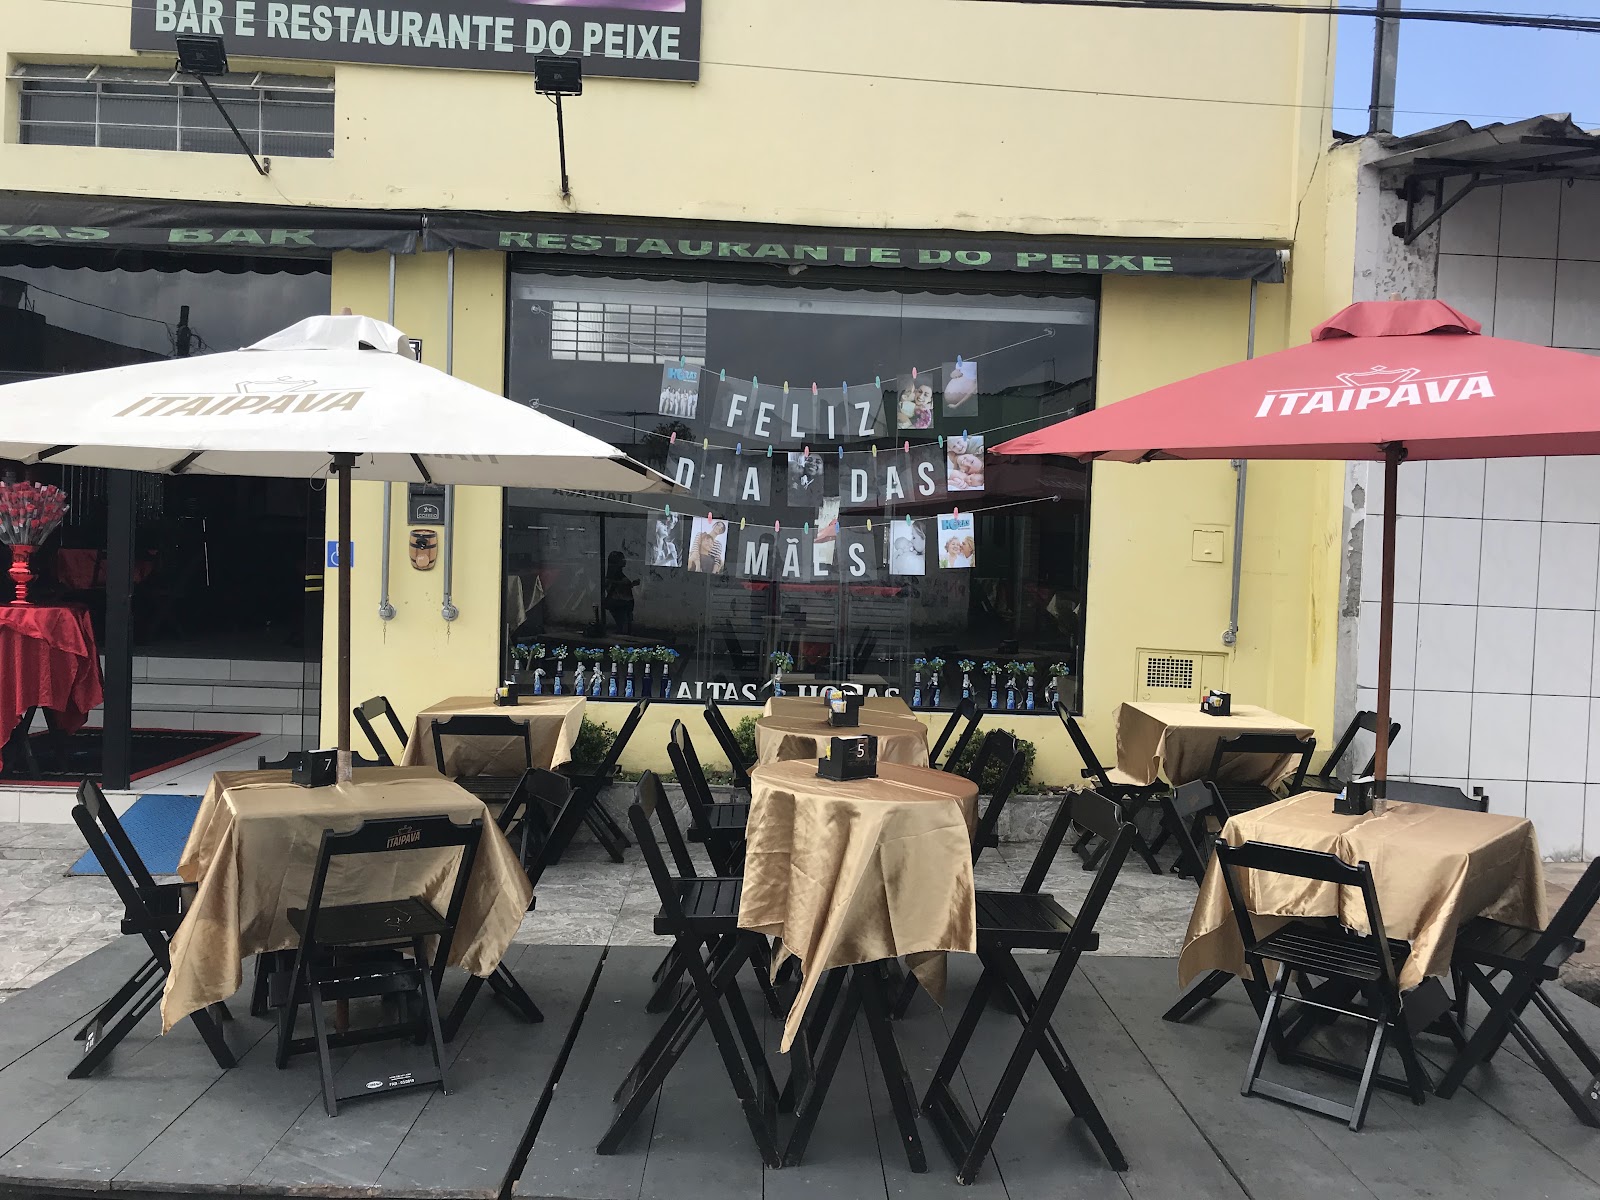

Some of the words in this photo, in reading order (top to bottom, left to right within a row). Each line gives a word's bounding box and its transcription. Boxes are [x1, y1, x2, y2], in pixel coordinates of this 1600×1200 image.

[155, 0, 224, 35] BAR
[235, 1, 255, 37] E
[267, 2, 515, 53] RESTAURANTE
[525, 18, 572, 56] DO
[582, 21, 681, 61] PEIXE
[0, 224, 110, 240] AS
[167, 227, 317, 246] BAR
[498, 231, 901, 263] RESTAURANTE
[918, 248, 993, 266] DO
[1016, 251, 1174, 272] PEIXE
[111, 390, 367, 417] ITAIPAVA
[1254, 375, 1496, 418] ITAIPAVA
[726, 393, 876, 440] FELIZ
[675, 456, 761, 501] DIA
[851, 461, 936, 503] DAS
[744, 537, 867, 577] MÃES
[324, 758, 332, 771] 7
[856, 743, 865, 758] 5
[1366, 787, 1373, 799] 4
[386, 831, 421, 848] ITAIPAVA
